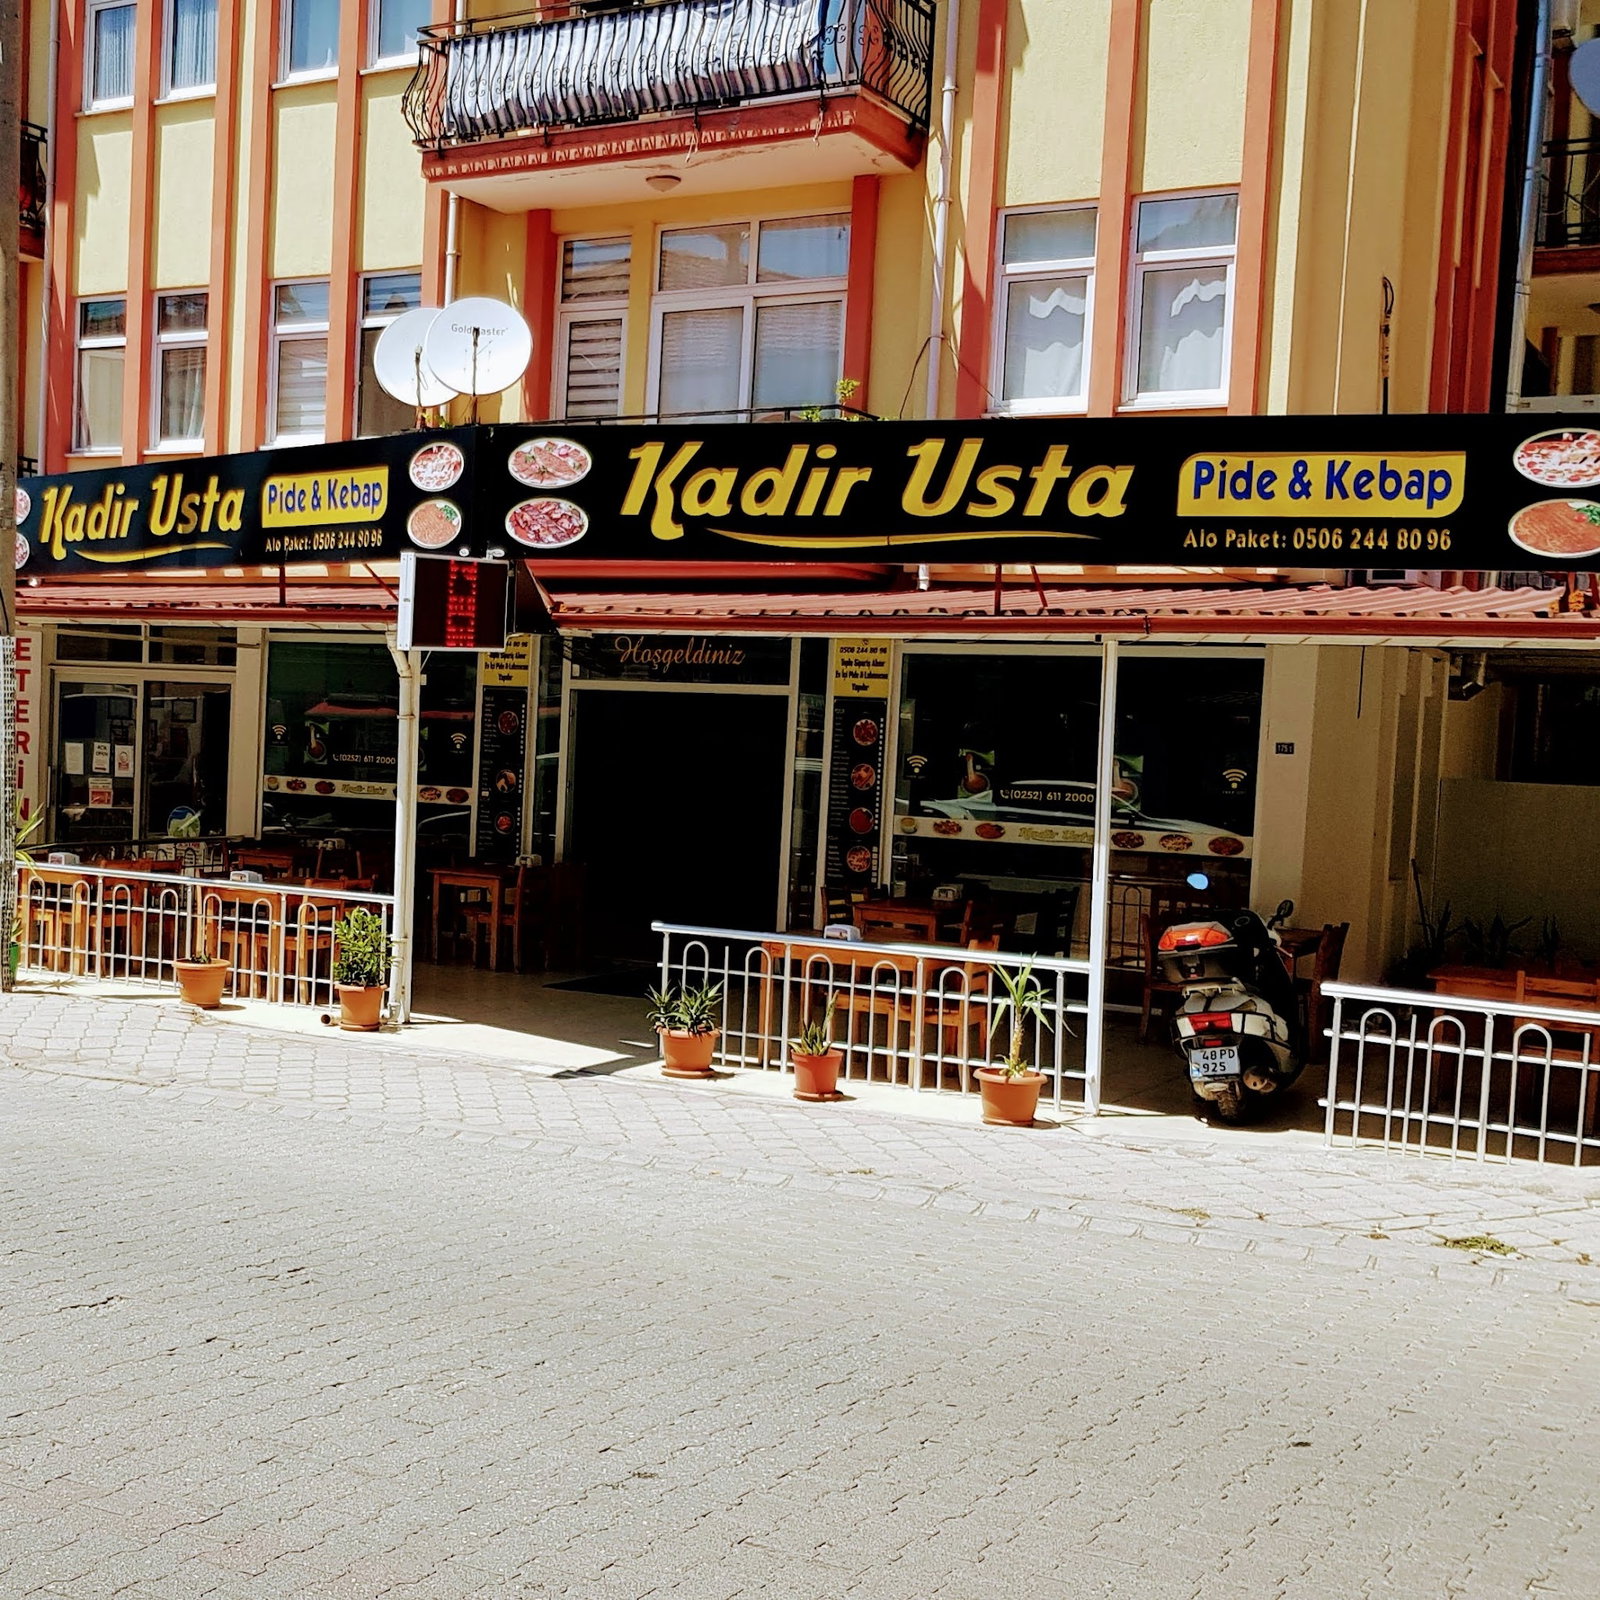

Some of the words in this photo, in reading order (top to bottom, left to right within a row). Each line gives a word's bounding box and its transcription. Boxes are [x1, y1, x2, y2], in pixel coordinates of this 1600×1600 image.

[451, 323, 506, 336] Goldaster
[267, 485, 306, 516] Pide
[311, 484, 323, 510] &
[327, 478, 383, 516] Kebap
[620, 441, 872, 540] Kadir
[902, 438, 1135, 518] Usta
[1193, 459, 1278, 500] Pide
[1288, 459, 1313, 500] &
[1325, 459, 1453, 510] Kebap
[39, 483, 139, 560] Kadir
[151, 472, 245, 536] Usta
[265, 537, 281, 552] Alo
[284, 535, 312, 551] Paket:
[313, 531, 336, 550] 0506
[338, 530, 355, 549] 244
[1183, 529, 1217, 549] Alo
[1225, 529, 1287, 549] Paket:
[1293, 528, 1343, 550] 0506
[1350, 528, 1389, 550] 244
[614, 636, 746, 673] Hoşgeldiniz
[1010, 788, 1043, 801] (0252)
[1046, 790, 1062, 802] 611
[1065, 791, 1094, 803] 2000
[1202, 1062, 1226, 1073] 925
